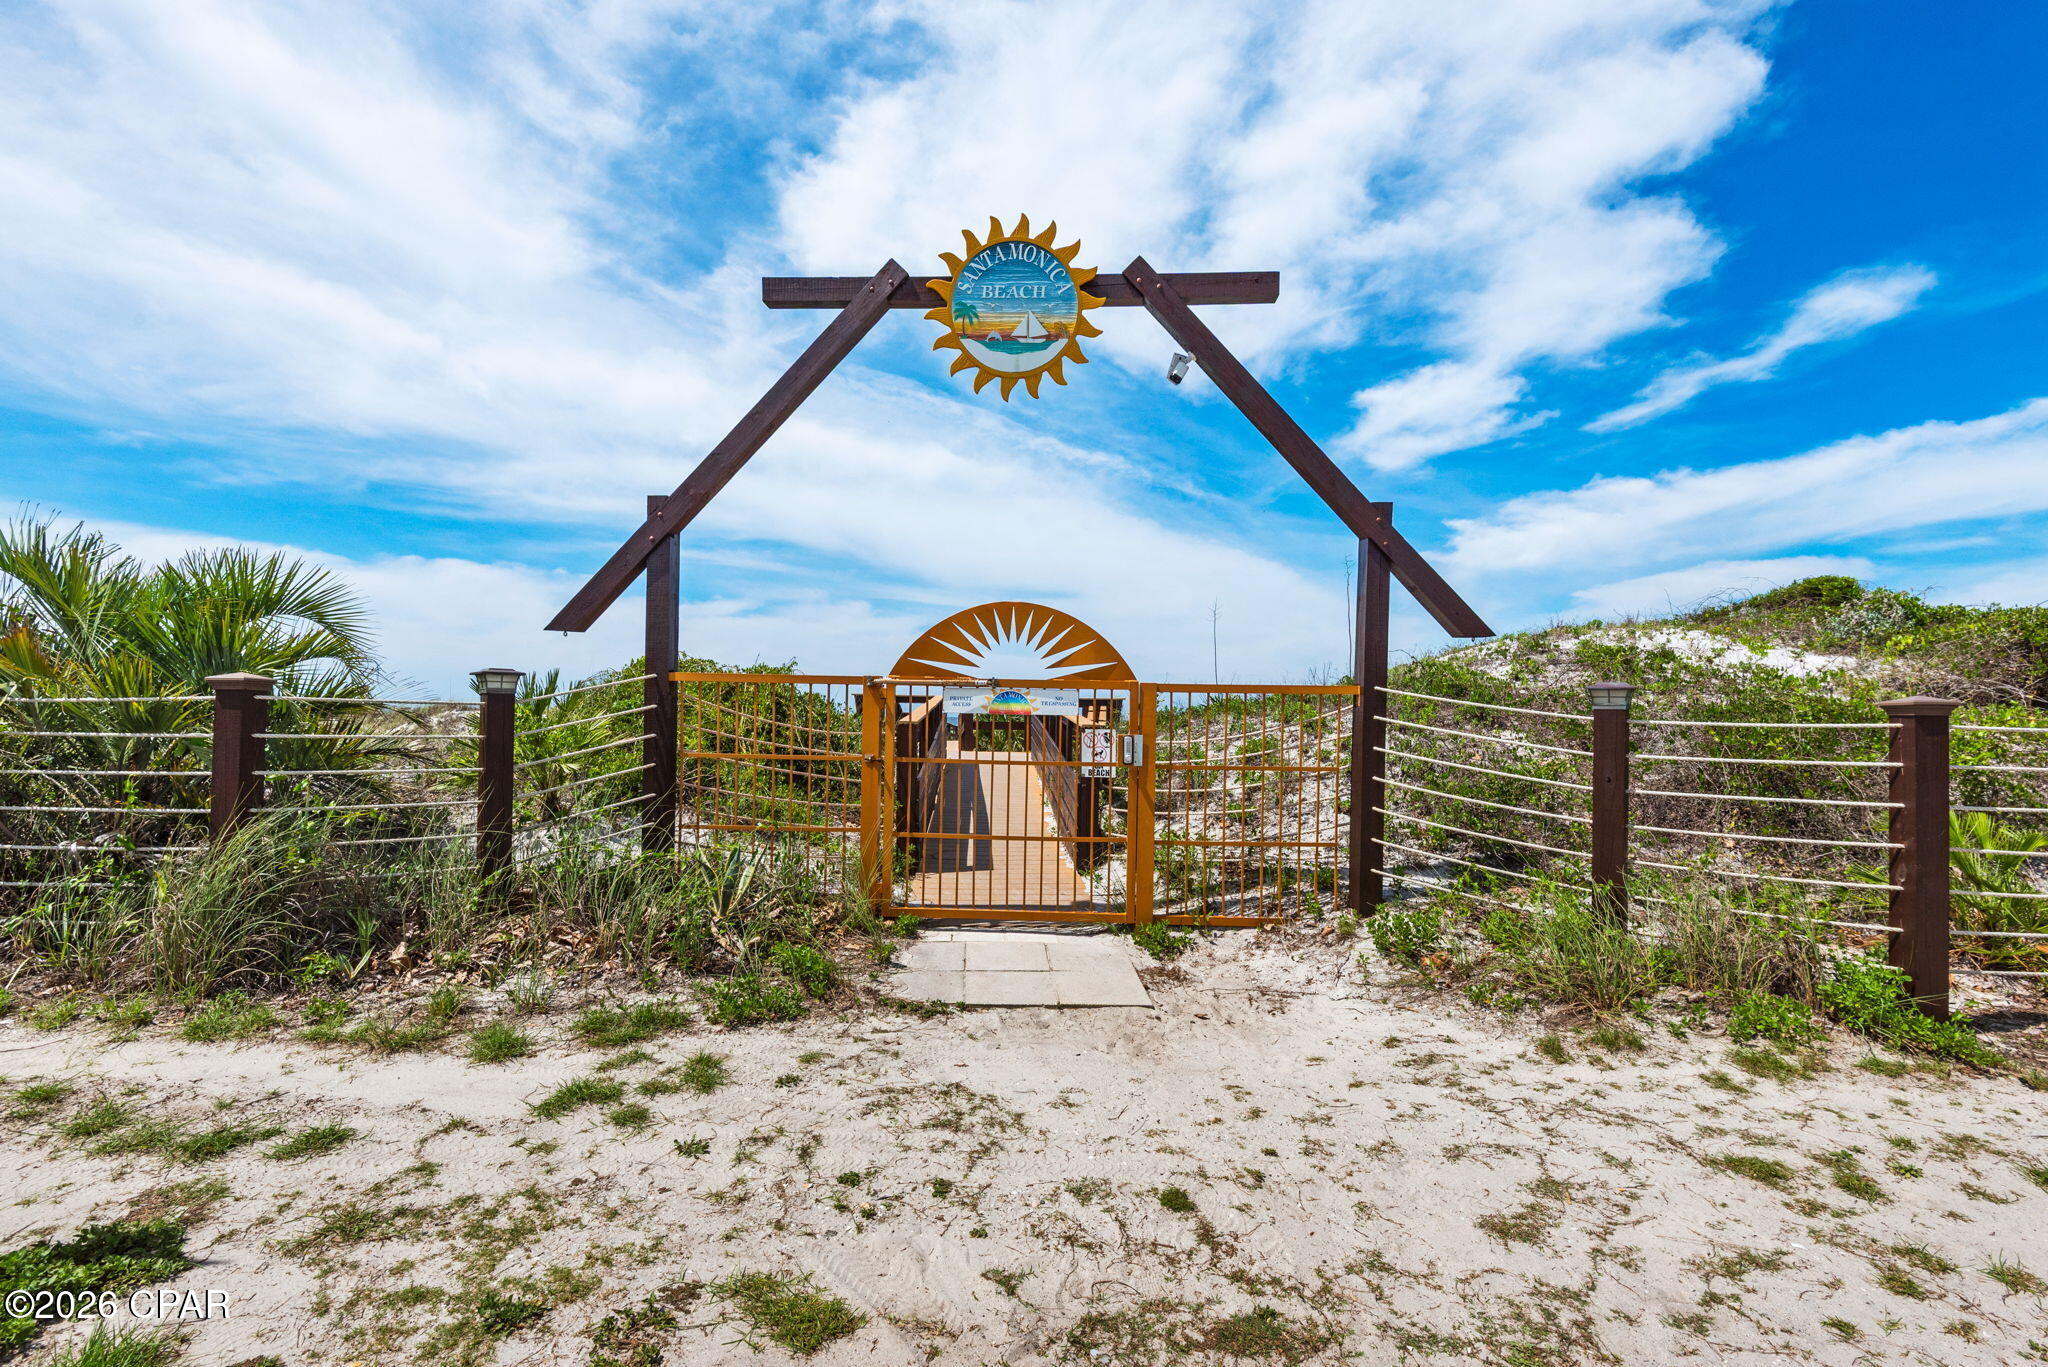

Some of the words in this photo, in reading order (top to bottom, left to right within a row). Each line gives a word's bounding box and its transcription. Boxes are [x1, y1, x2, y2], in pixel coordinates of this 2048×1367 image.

[957, 245, 1007, 294] SANTA
[1009, 243, 1072, 295] MONICA
[981, 285, 1047, 298] BEACH
